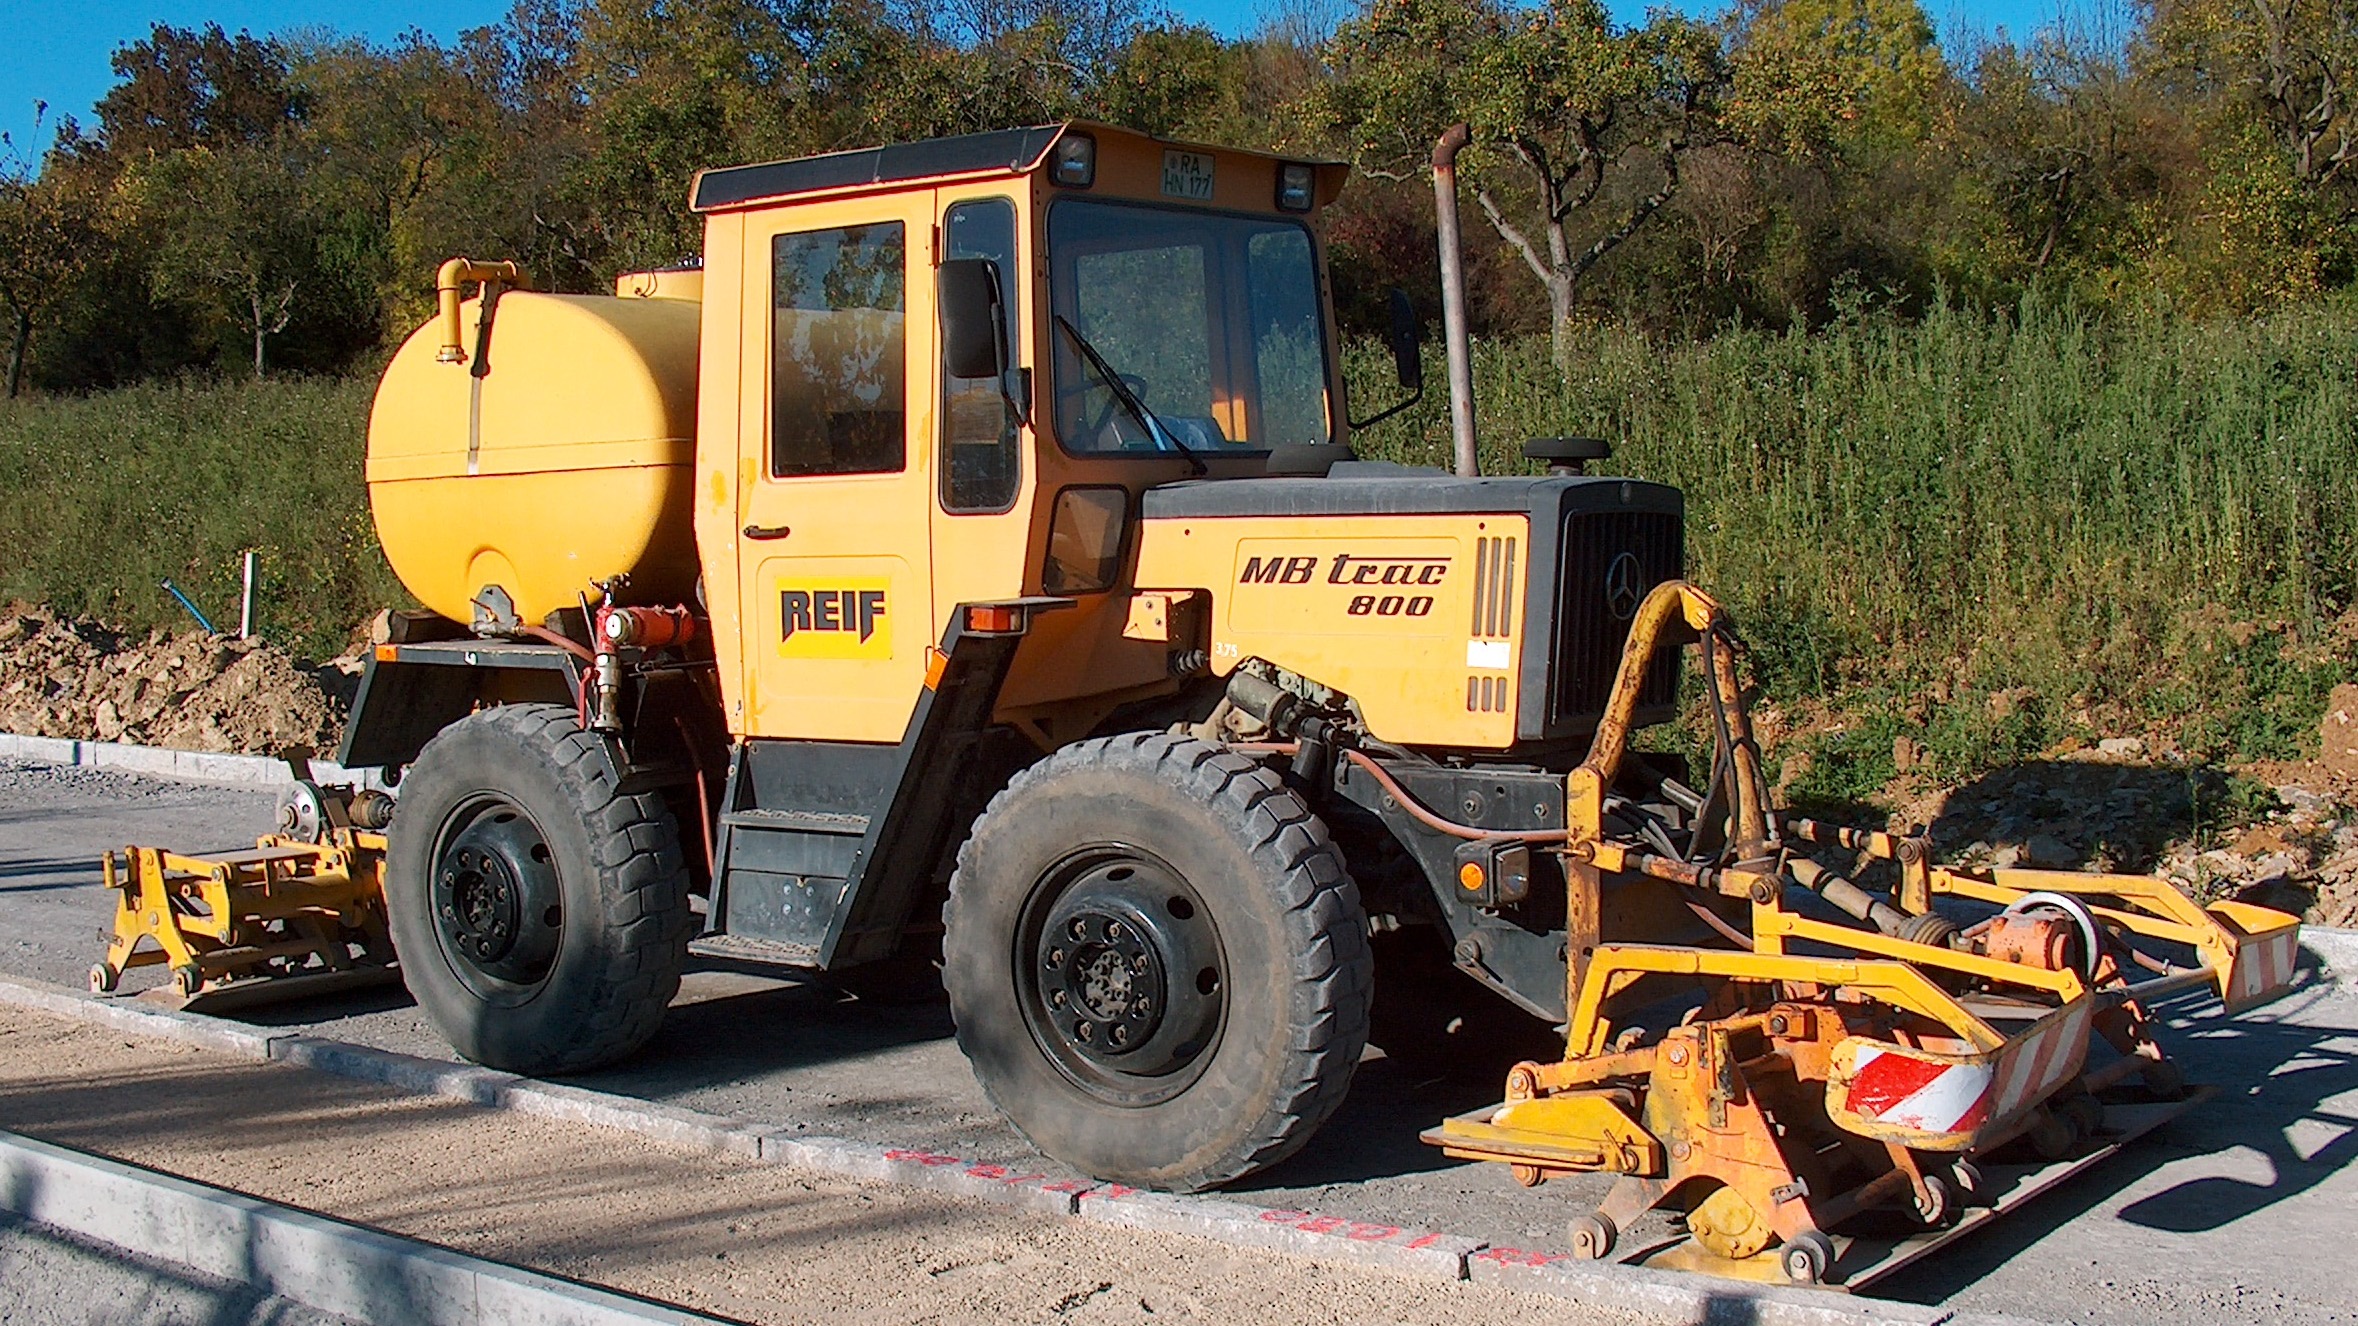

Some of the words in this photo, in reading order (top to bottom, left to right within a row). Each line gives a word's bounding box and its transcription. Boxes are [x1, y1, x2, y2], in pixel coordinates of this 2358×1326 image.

[1181, 155, 1200, 175] RA
[1190, 174, 1212, 197] 177
[1239, 557, 1318, 584] MB
[1327, 553, 1452, 585] trac
[780, 590, 885, 644] REIF
[1347, 595, 1434, 616] 800
